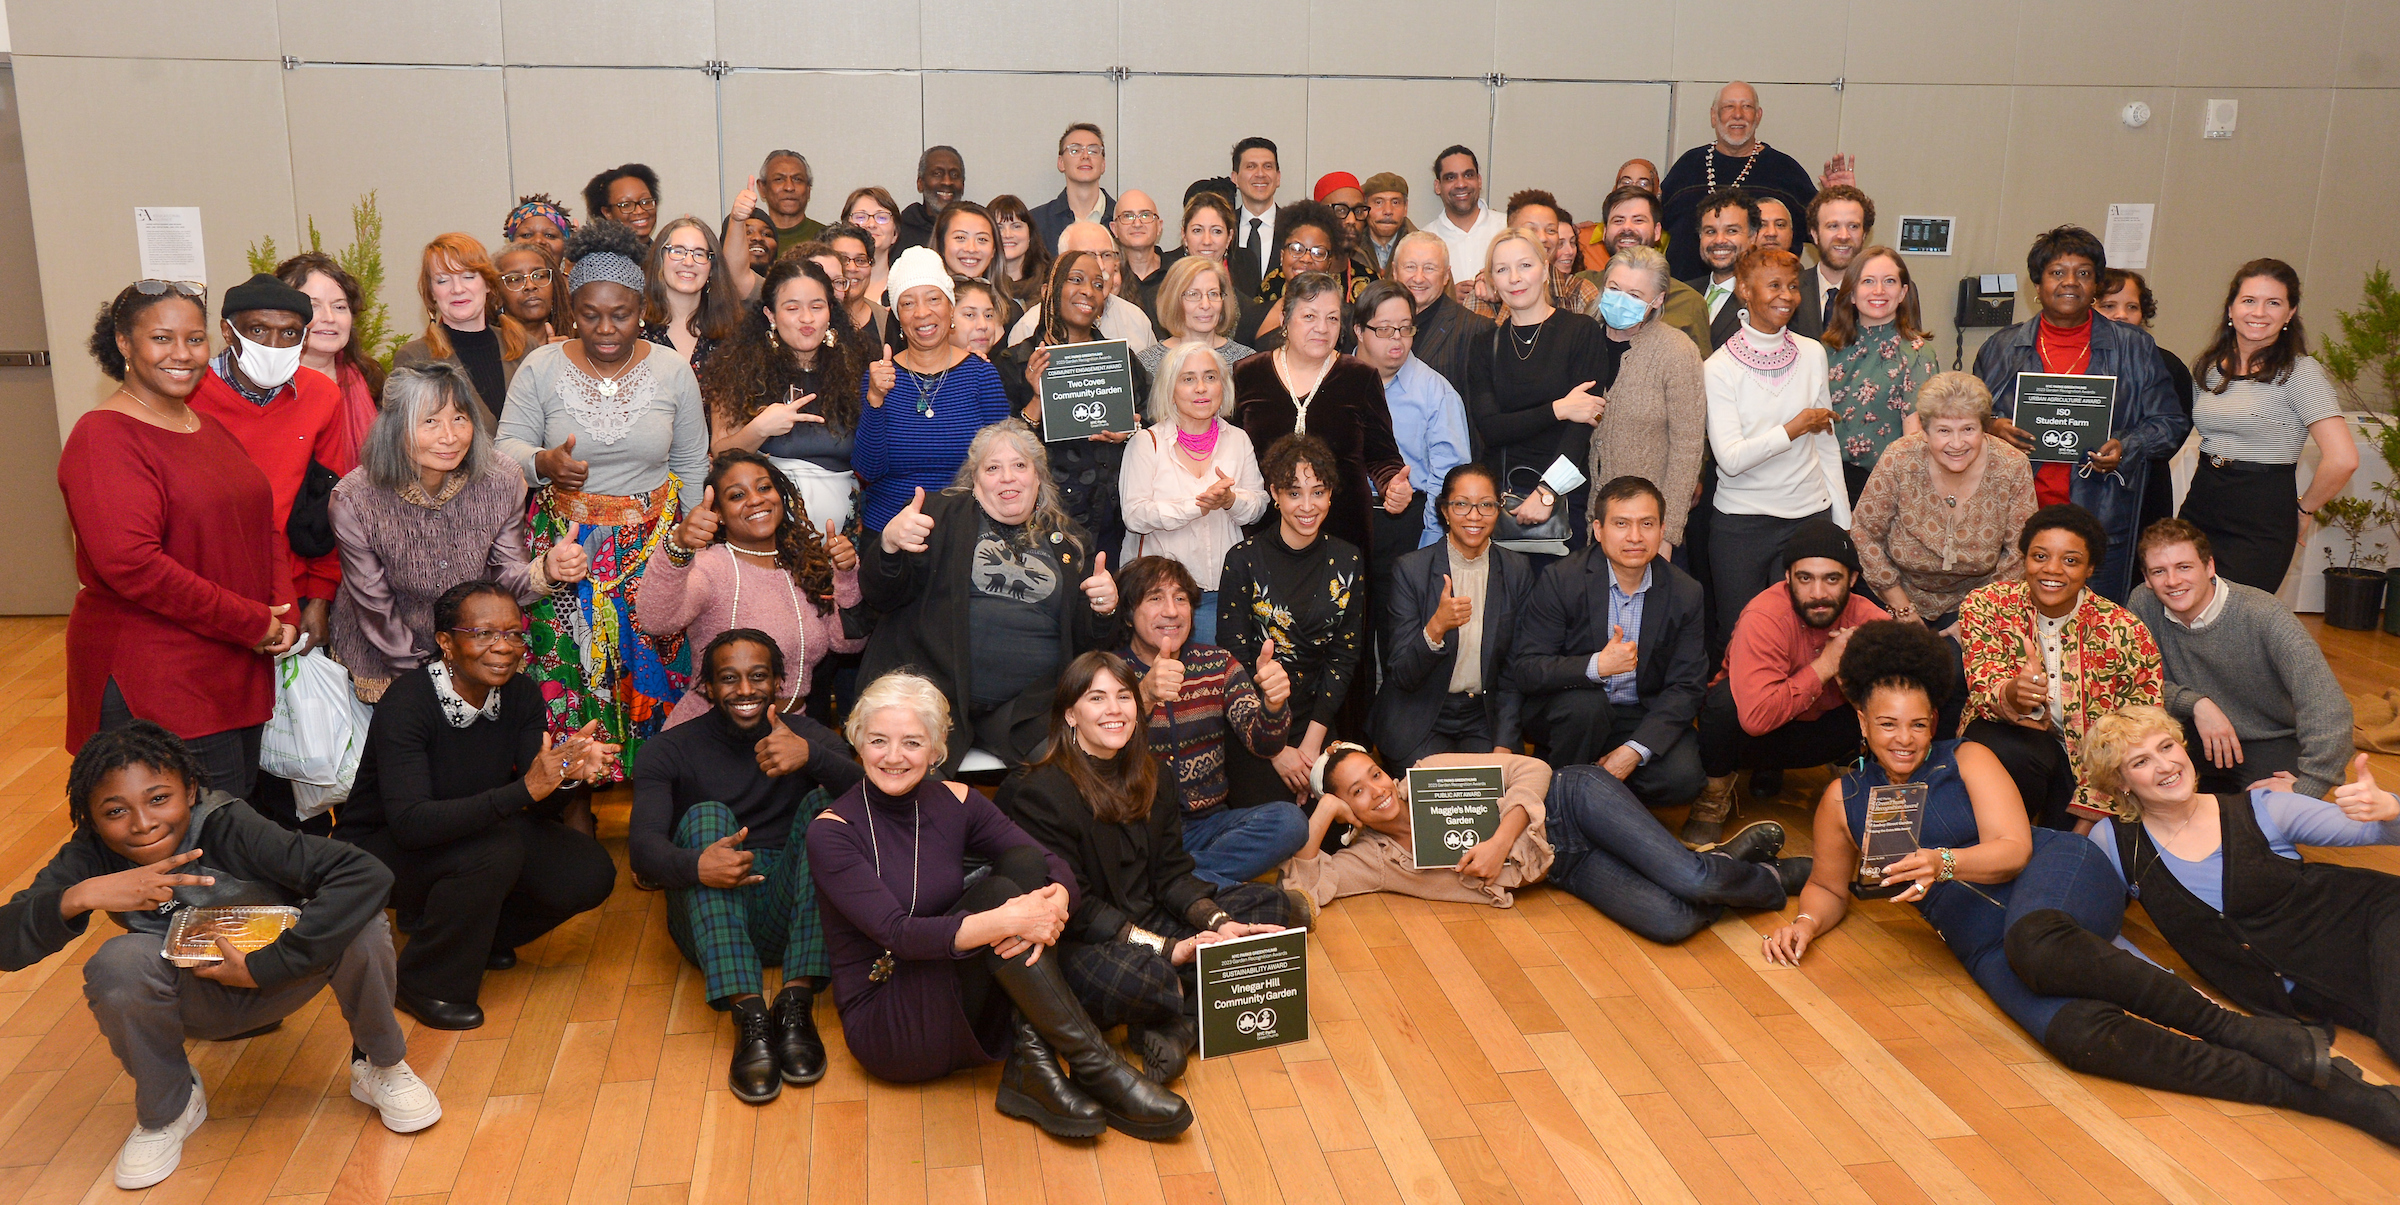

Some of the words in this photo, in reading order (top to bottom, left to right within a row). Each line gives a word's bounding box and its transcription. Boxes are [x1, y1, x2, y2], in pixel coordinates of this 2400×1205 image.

[1076, 366, 1106, 374] ENGAGEMENT
[1067, 380, 1083, 388] Two
[1084, 378, 1106, 386] Coves
[1052, 388, 1095, 400] Community
[1096, 386, 1122, 396] Garden
[2036, 416, 2068, 426] Student
[2068, 418, 2089, 426] Farm
[1430, 806, 1464, 816] Maggie's
[1464, 805, 1488, 815] Magic
[1446, 816, 1474, 825] Garden
[1222, 966, 1267, 978] SUSTAINABILITY
[1267, 962, 1288, 970] AWARD
[1231, 982, 1264, 994] Vinegar
[1266, 977, 1280, 988] Hill
[1214, 994, 1266, 1009] Community
[1266, 988, 1298, 1000] Garden
